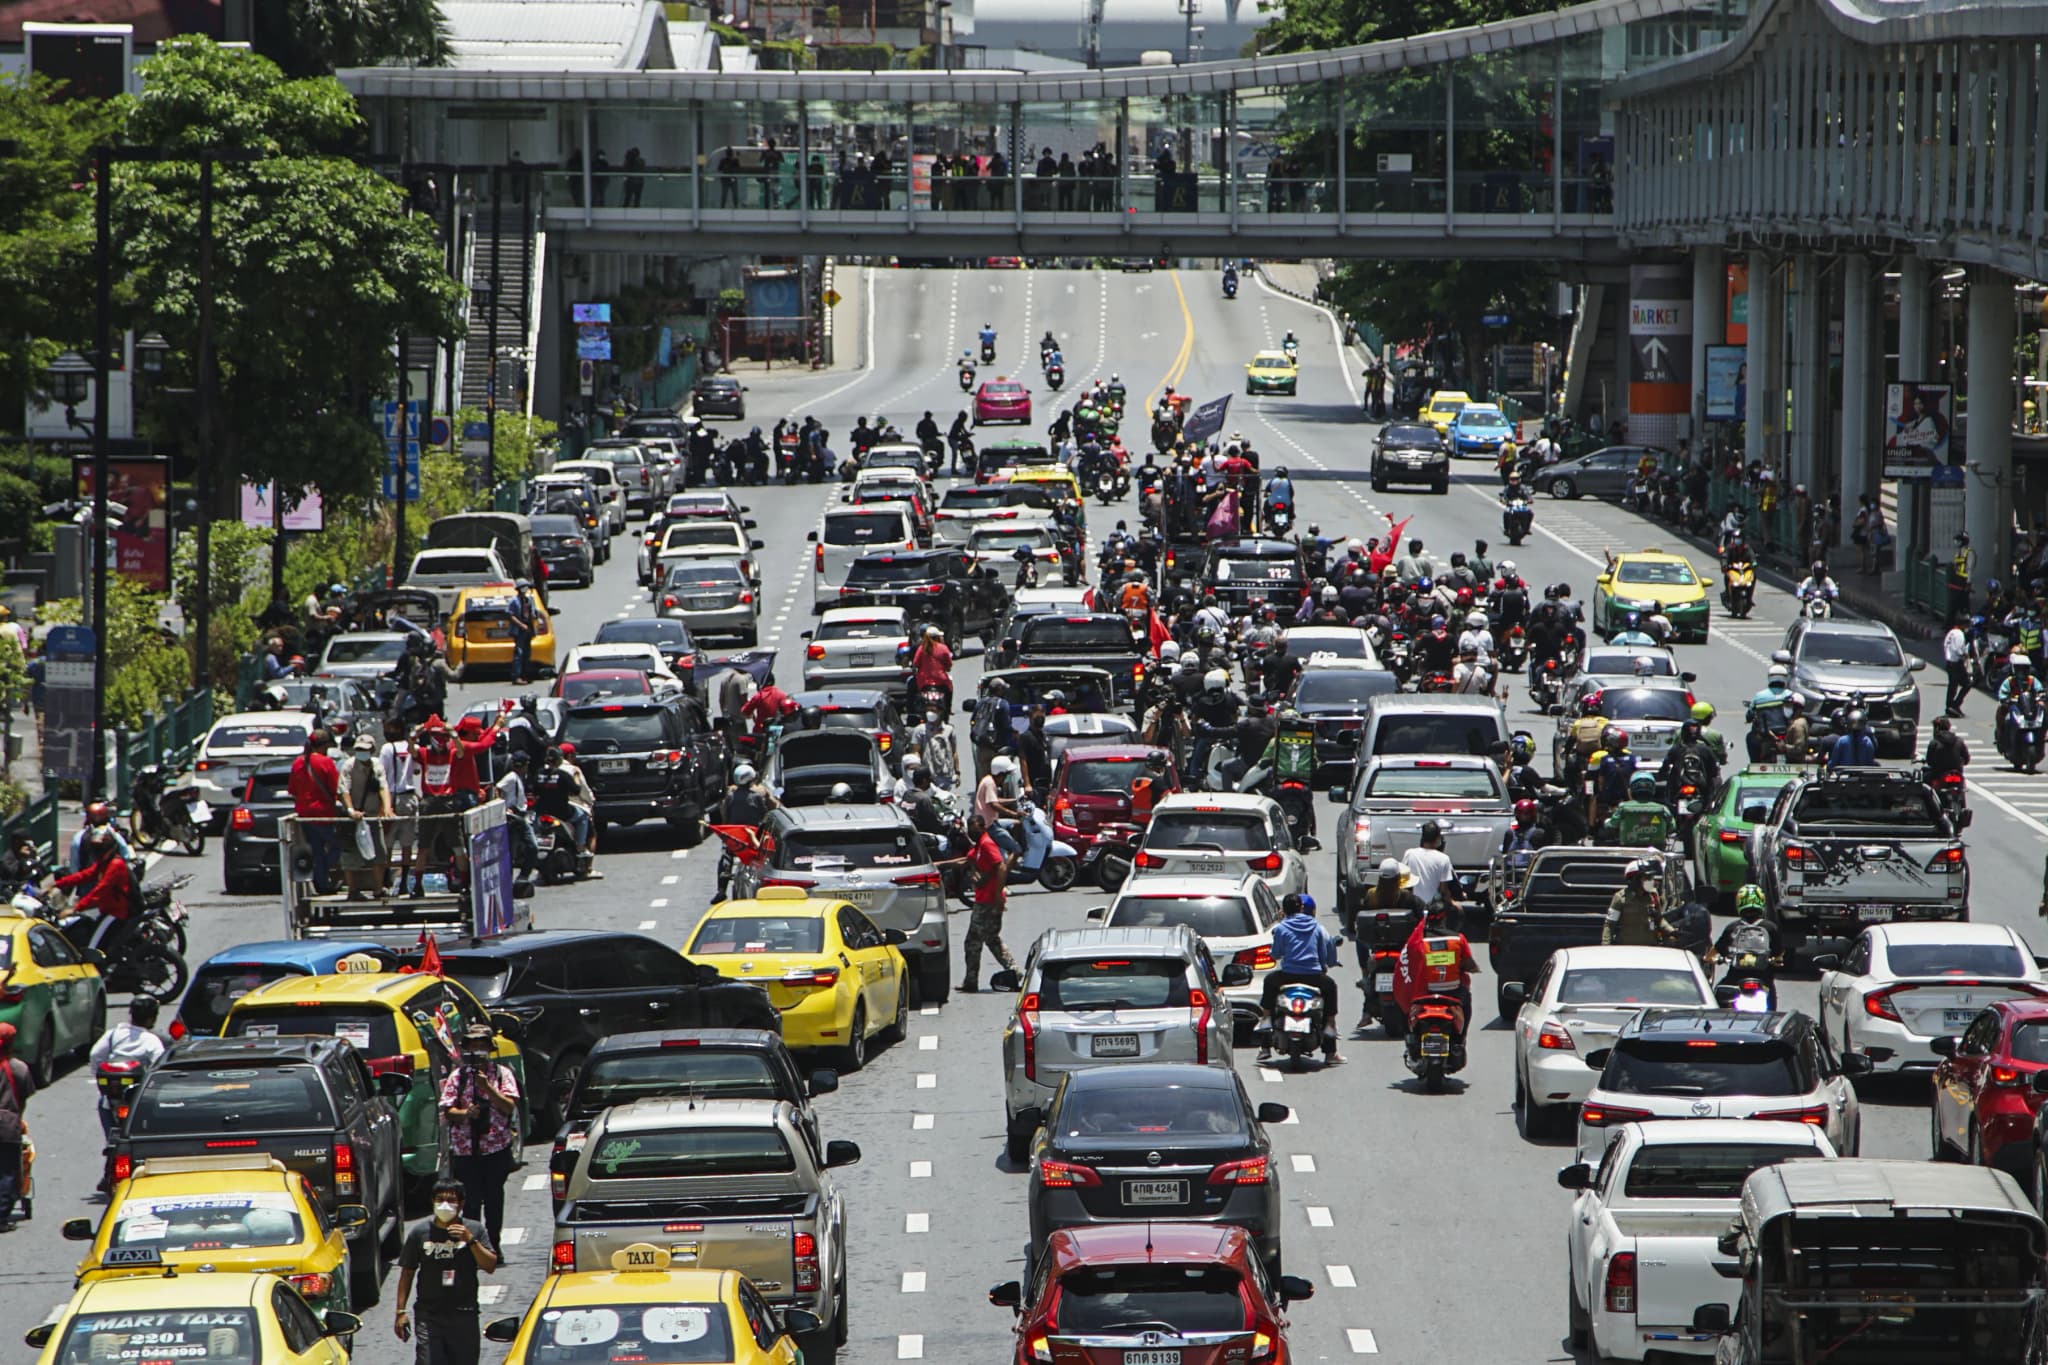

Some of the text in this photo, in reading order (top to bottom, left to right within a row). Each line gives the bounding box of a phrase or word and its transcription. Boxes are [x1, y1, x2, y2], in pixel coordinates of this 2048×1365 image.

[1633, 308, 1680, 325] MARKET
[1267, 567, 1291, 579] 112
[1632, 824, 1658, 834] Grab
[348, 959, 369, 973] TAXI
[294, 1148, 328, 1157] HILUX
[1155, 1183, 1178, 1193] 4284
[114, 1250, 150, 1262] TAXI
[627, 1251, 655, 1265] TAXI
[76, 1312, 248, 1333] SMART TAXI
[129, 1332, 185, 1345] 2201
[1151, 1352, 1179, 1364] 9139
